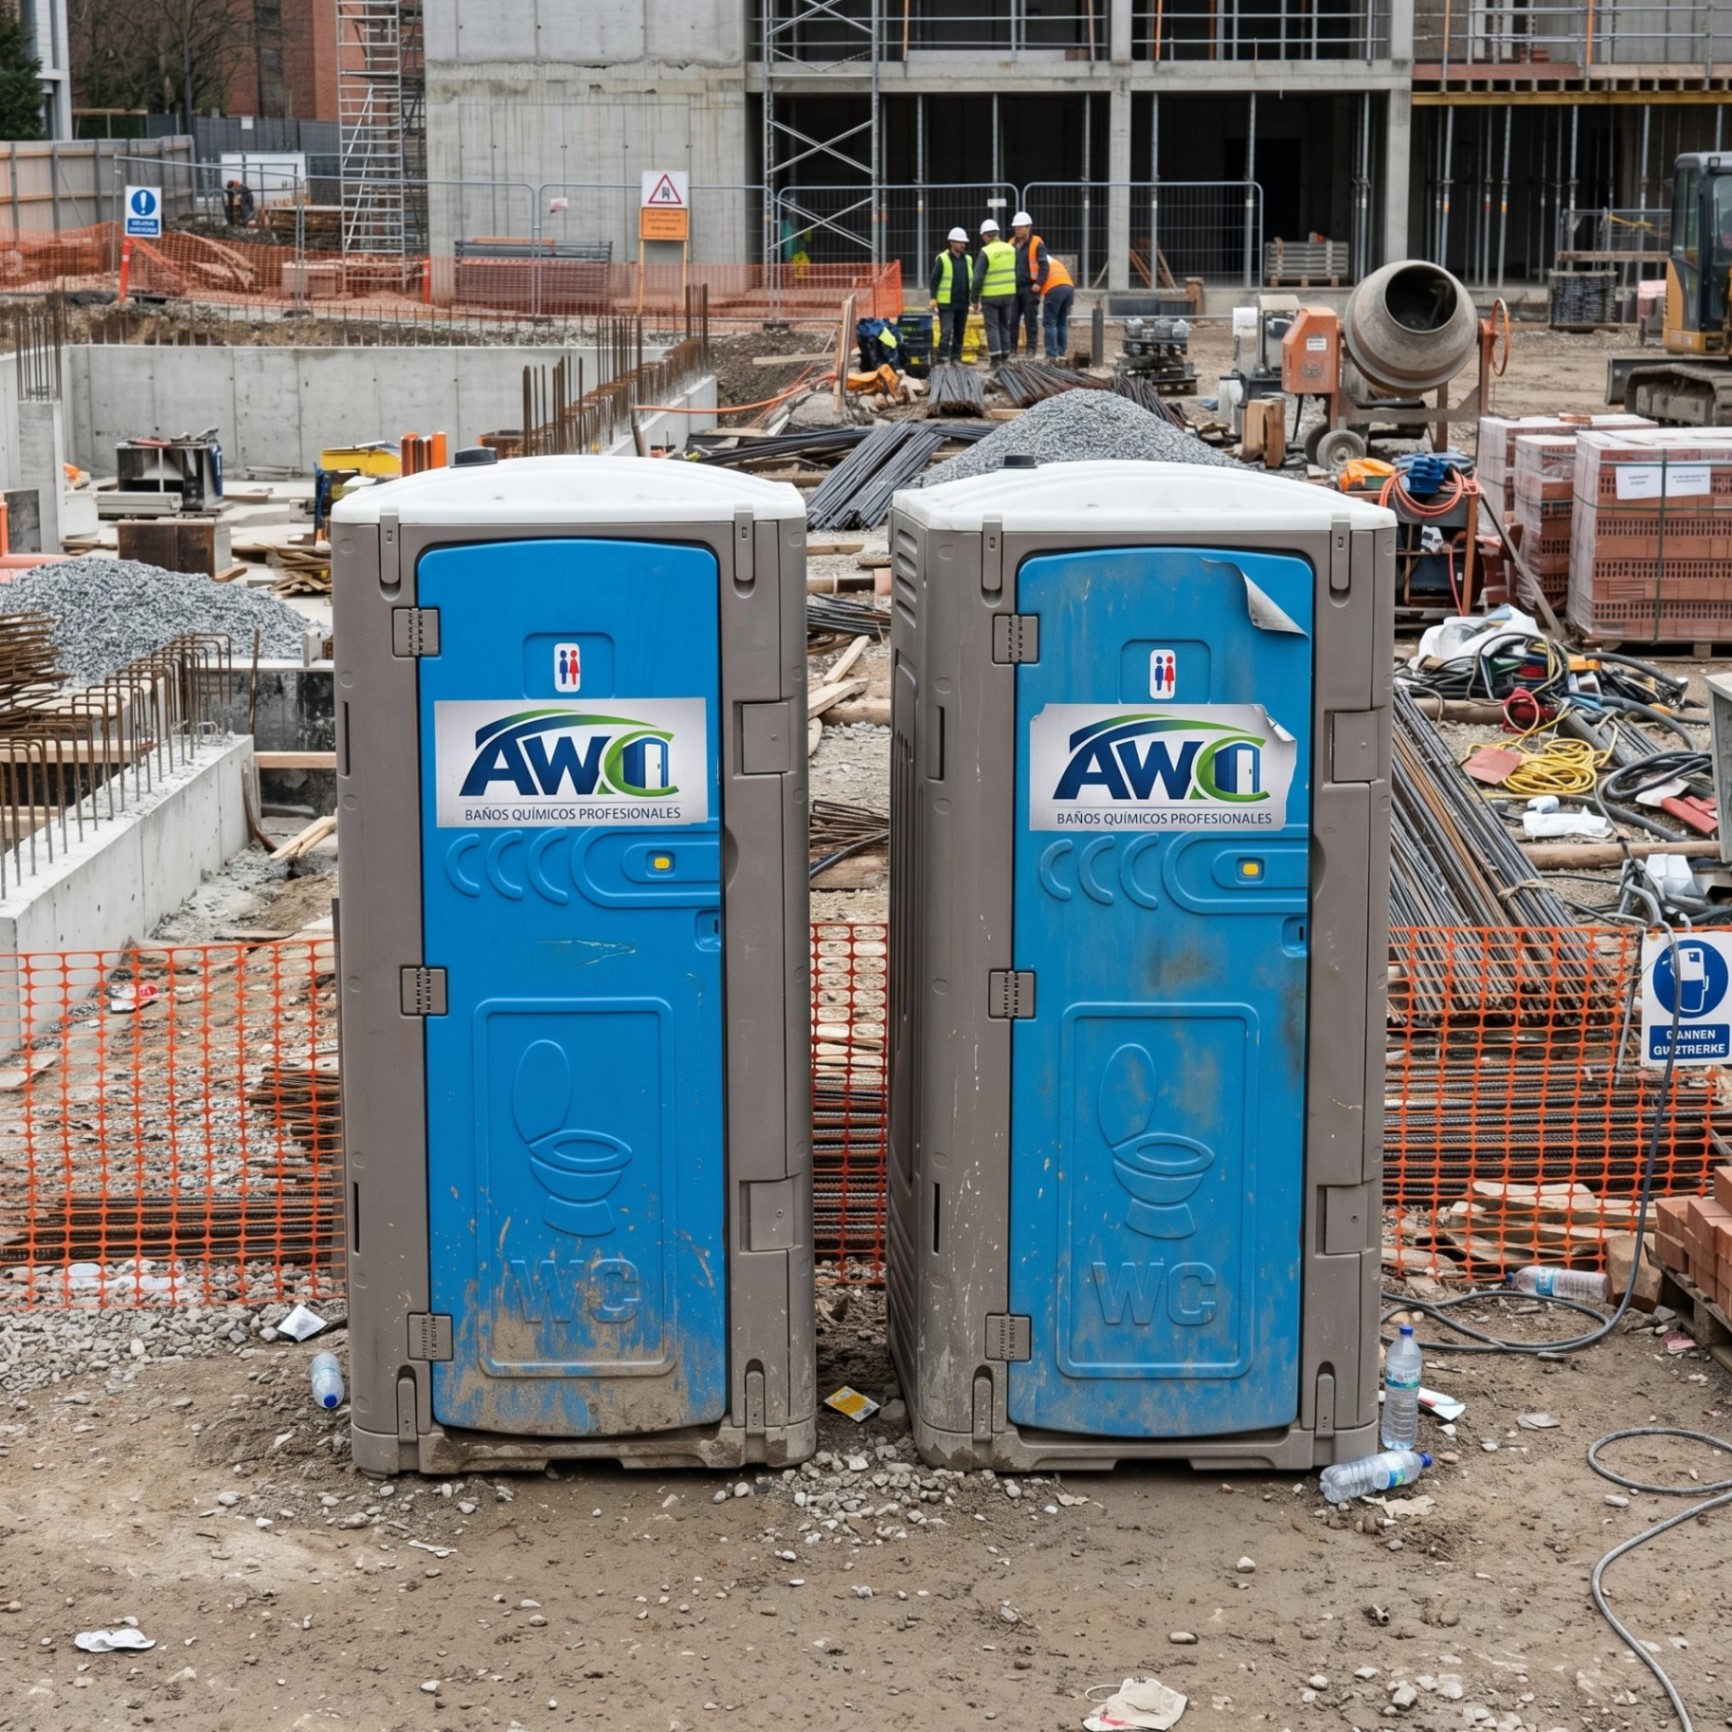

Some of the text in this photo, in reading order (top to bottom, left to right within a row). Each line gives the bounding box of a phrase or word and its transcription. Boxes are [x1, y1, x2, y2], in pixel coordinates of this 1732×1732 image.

[459, 715, 680, 798] AWC
[1052, 720, 1271, 803] AWC
[465, 807, 681, 822] BAÑOS QUÍMICOS PROFESIONALES
[1057, 811, 1272, 825] BAÑOS QUÍMICOS PROFESIONALES
[510, 1258, 640, 1324] WC
[1091, 1261, 1218, 1326] WC
